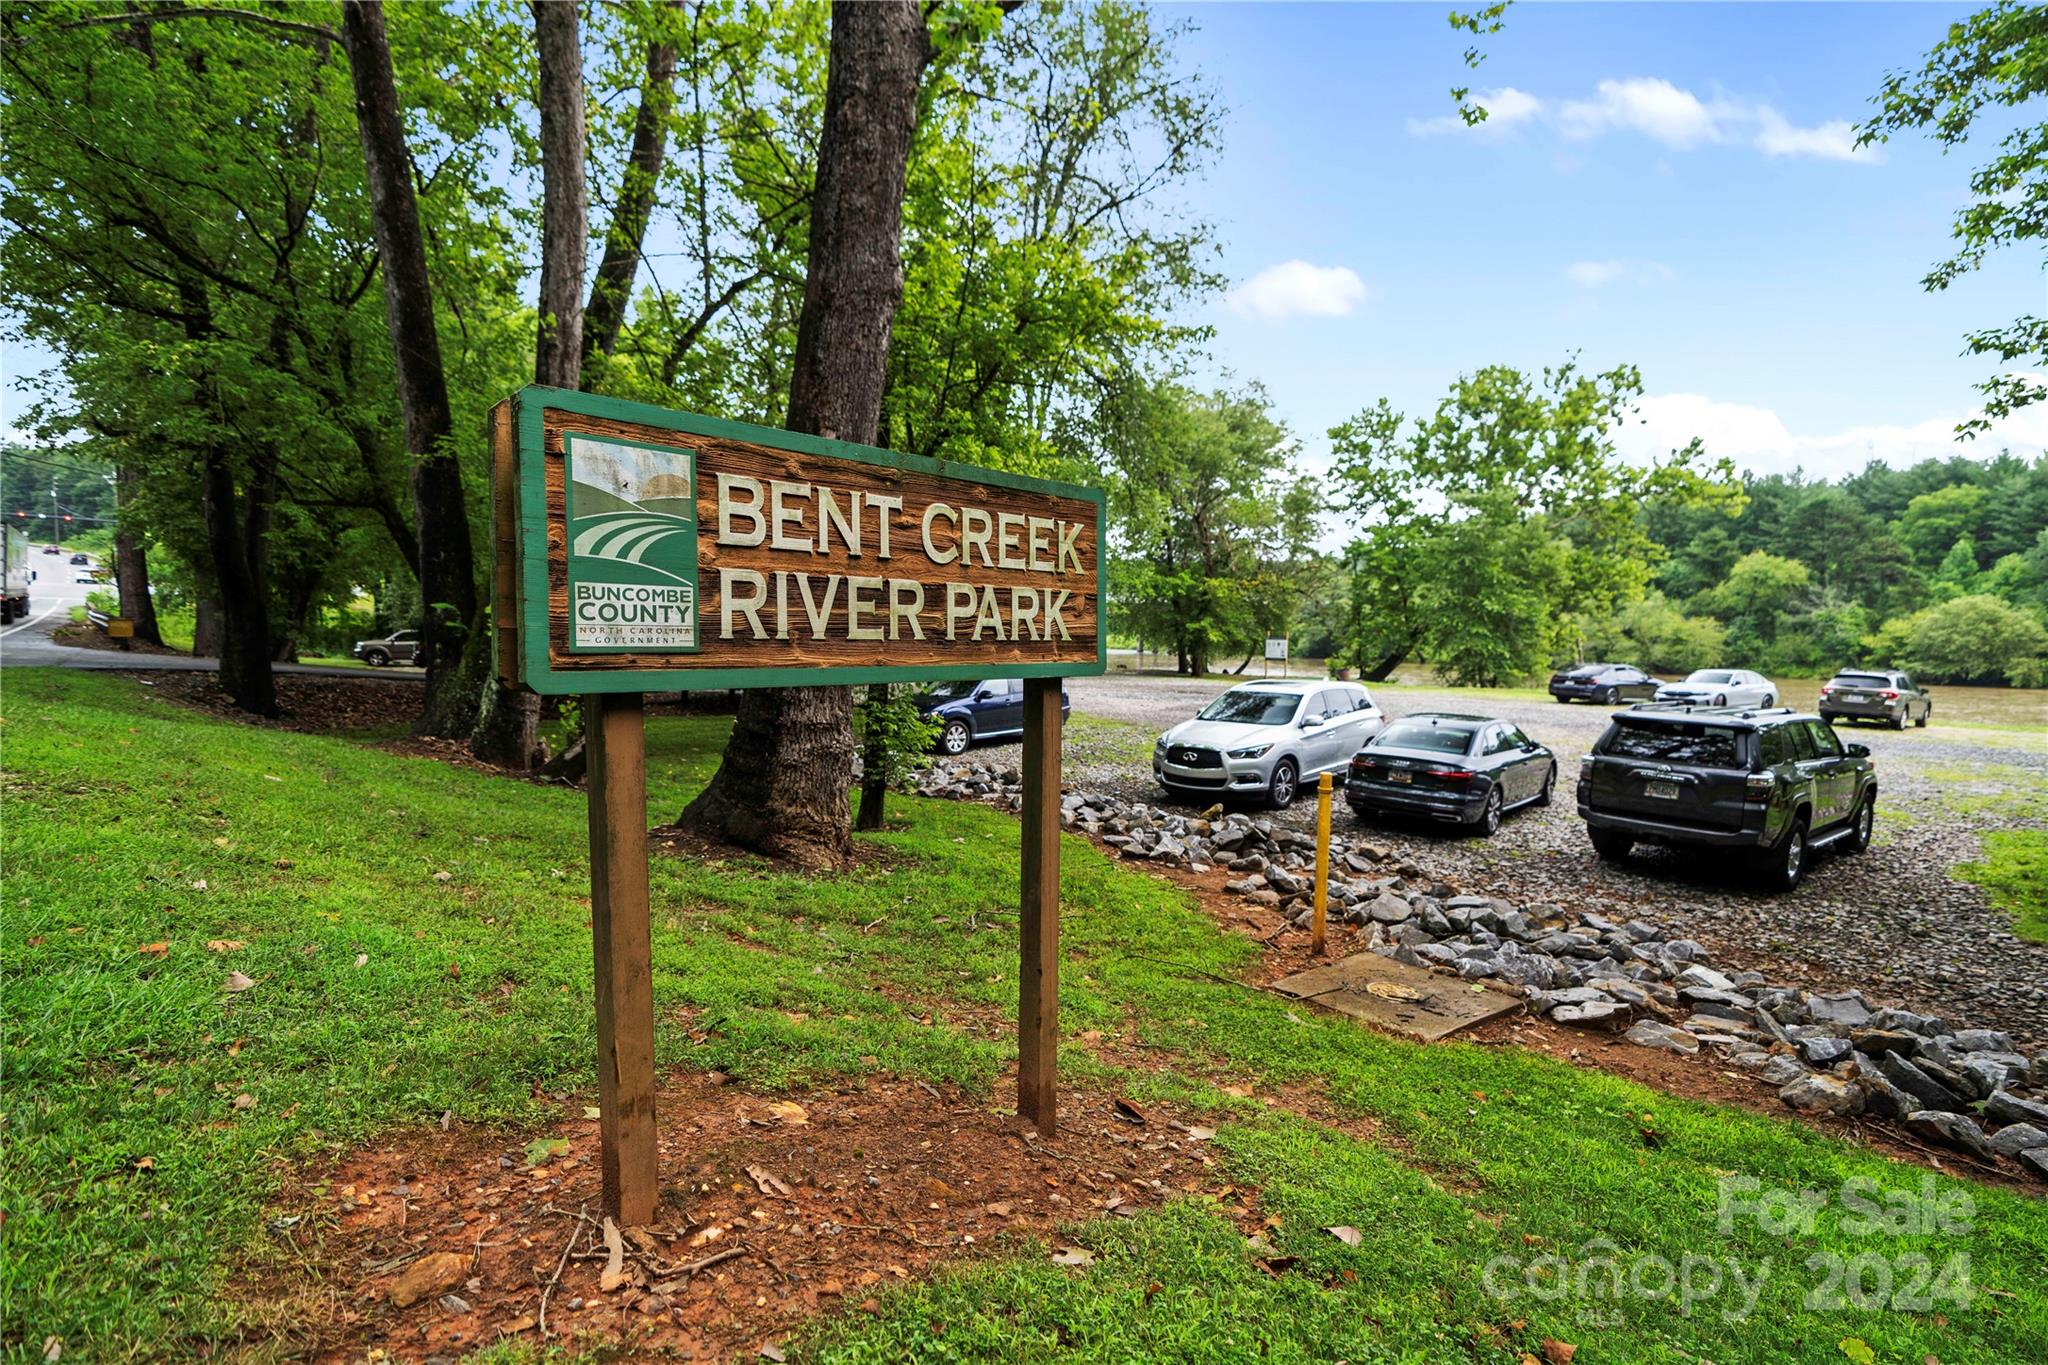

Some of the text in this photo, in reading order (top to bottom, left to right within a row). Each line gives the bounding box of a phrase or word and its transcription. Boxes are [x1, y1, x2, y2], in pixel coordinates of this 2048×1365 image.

[716, 472, 1085, 575] BENT CREEK
[577, 585, 691, 603] BUNCOMBE
[717, 567, 1073, 641] RIVER PARK
[578, 602, 691, 623] COUNTY
[579, 627, 622, 635] NORTH
